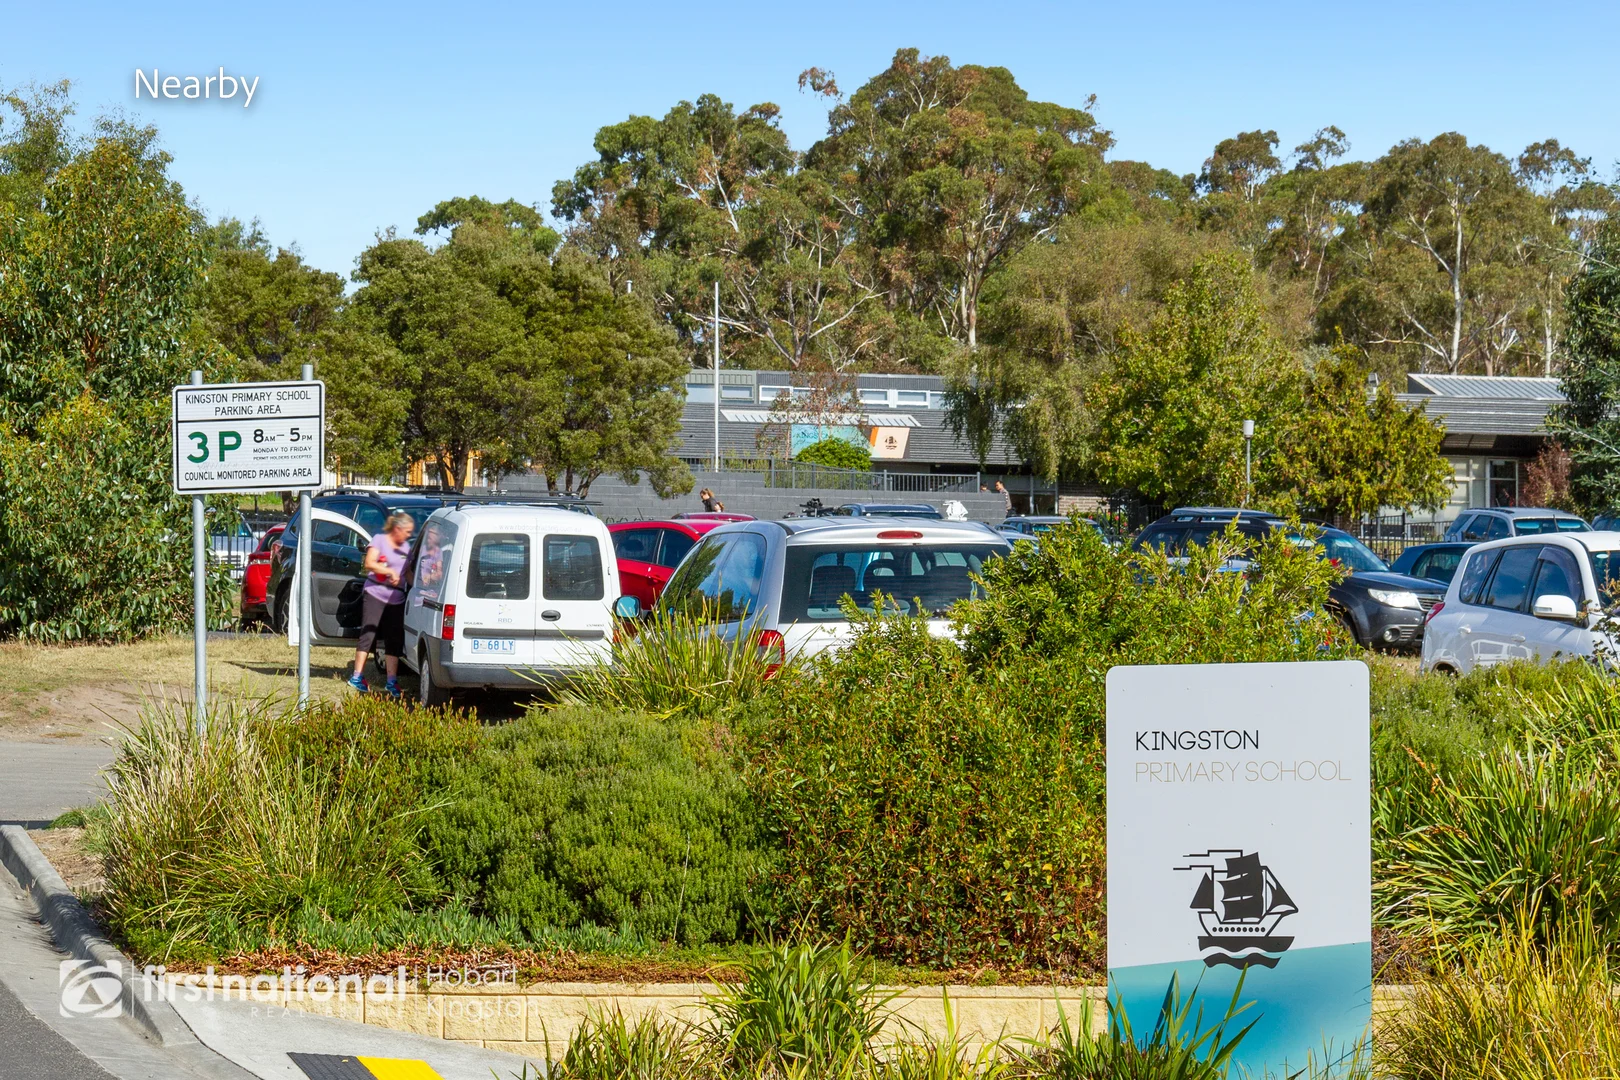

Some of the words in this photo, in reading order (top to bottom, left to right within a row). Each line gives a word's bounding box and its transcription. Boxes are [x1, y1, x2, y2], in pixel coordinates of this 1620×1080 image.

[185, 393, 228, 404] KINGSTON
[232, 391, 272, 403] PRIMARY
[276, 390, 311, 401] SCHOOL
[215, 405, 253, 416] PARKING
[257, 404, 282, 415] AREA
[184, 471, 215, 482] COUNCIL
[216, 469, 257, 481] MONITORED
[259, 468, 291, 479] PARKING
[292, 467, 312, 478] AREA
[1135, 729, 1260, 751] KINGSTON
[1135, 761, 1240, 783] PRIMARY
[1244, 760, 1352, 782] SCHOOL
